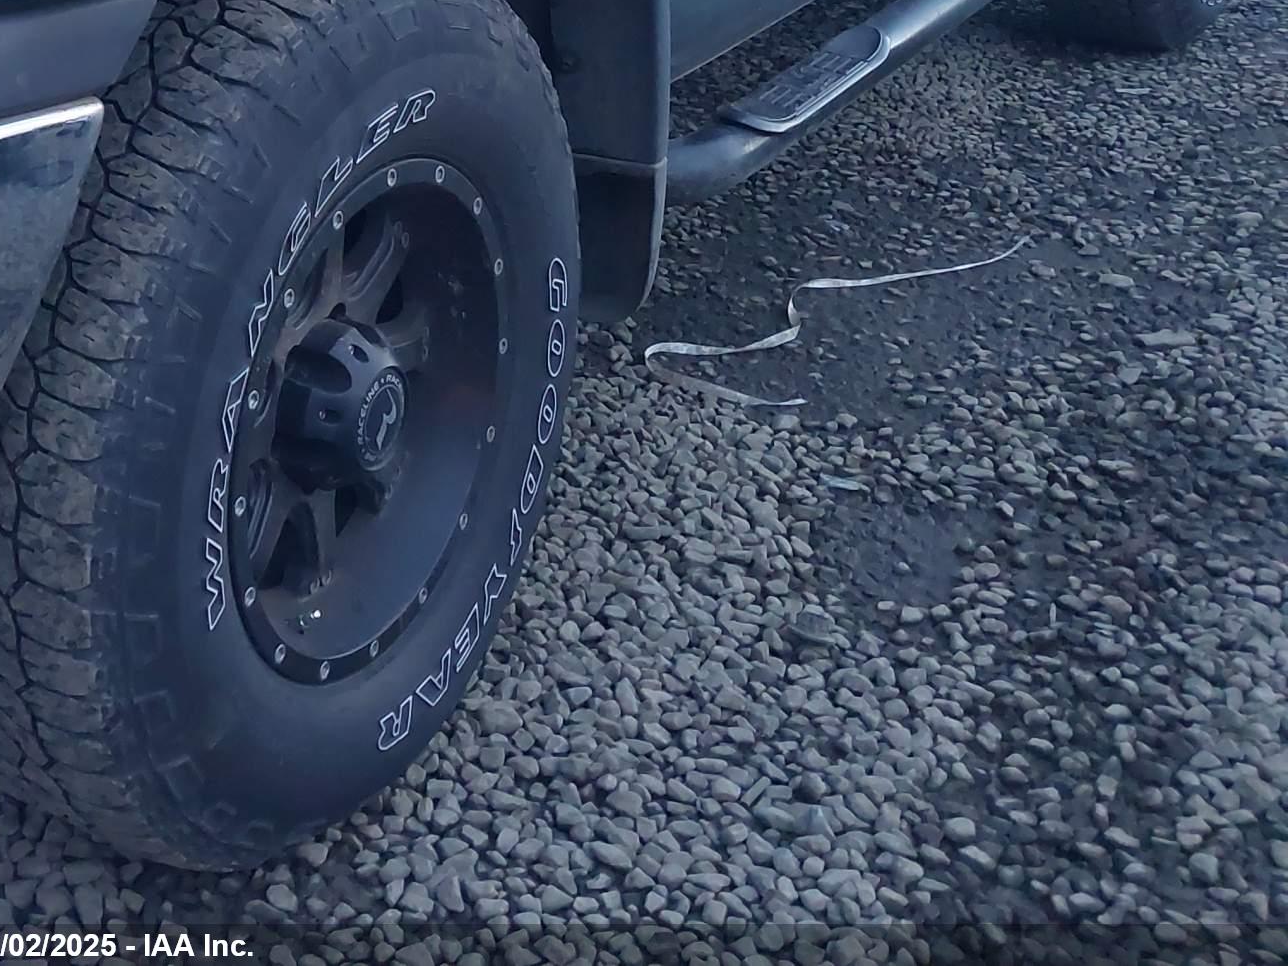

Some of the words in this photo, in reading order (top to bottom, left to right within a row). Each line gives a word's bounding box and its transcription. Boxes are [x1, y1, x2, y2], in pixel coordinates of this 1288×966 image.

[205, 89, 436, 631] WRANGLER
[357, 381, 381, 445] RACELINE
[377, 258, 568, 752] GOODYEAR
